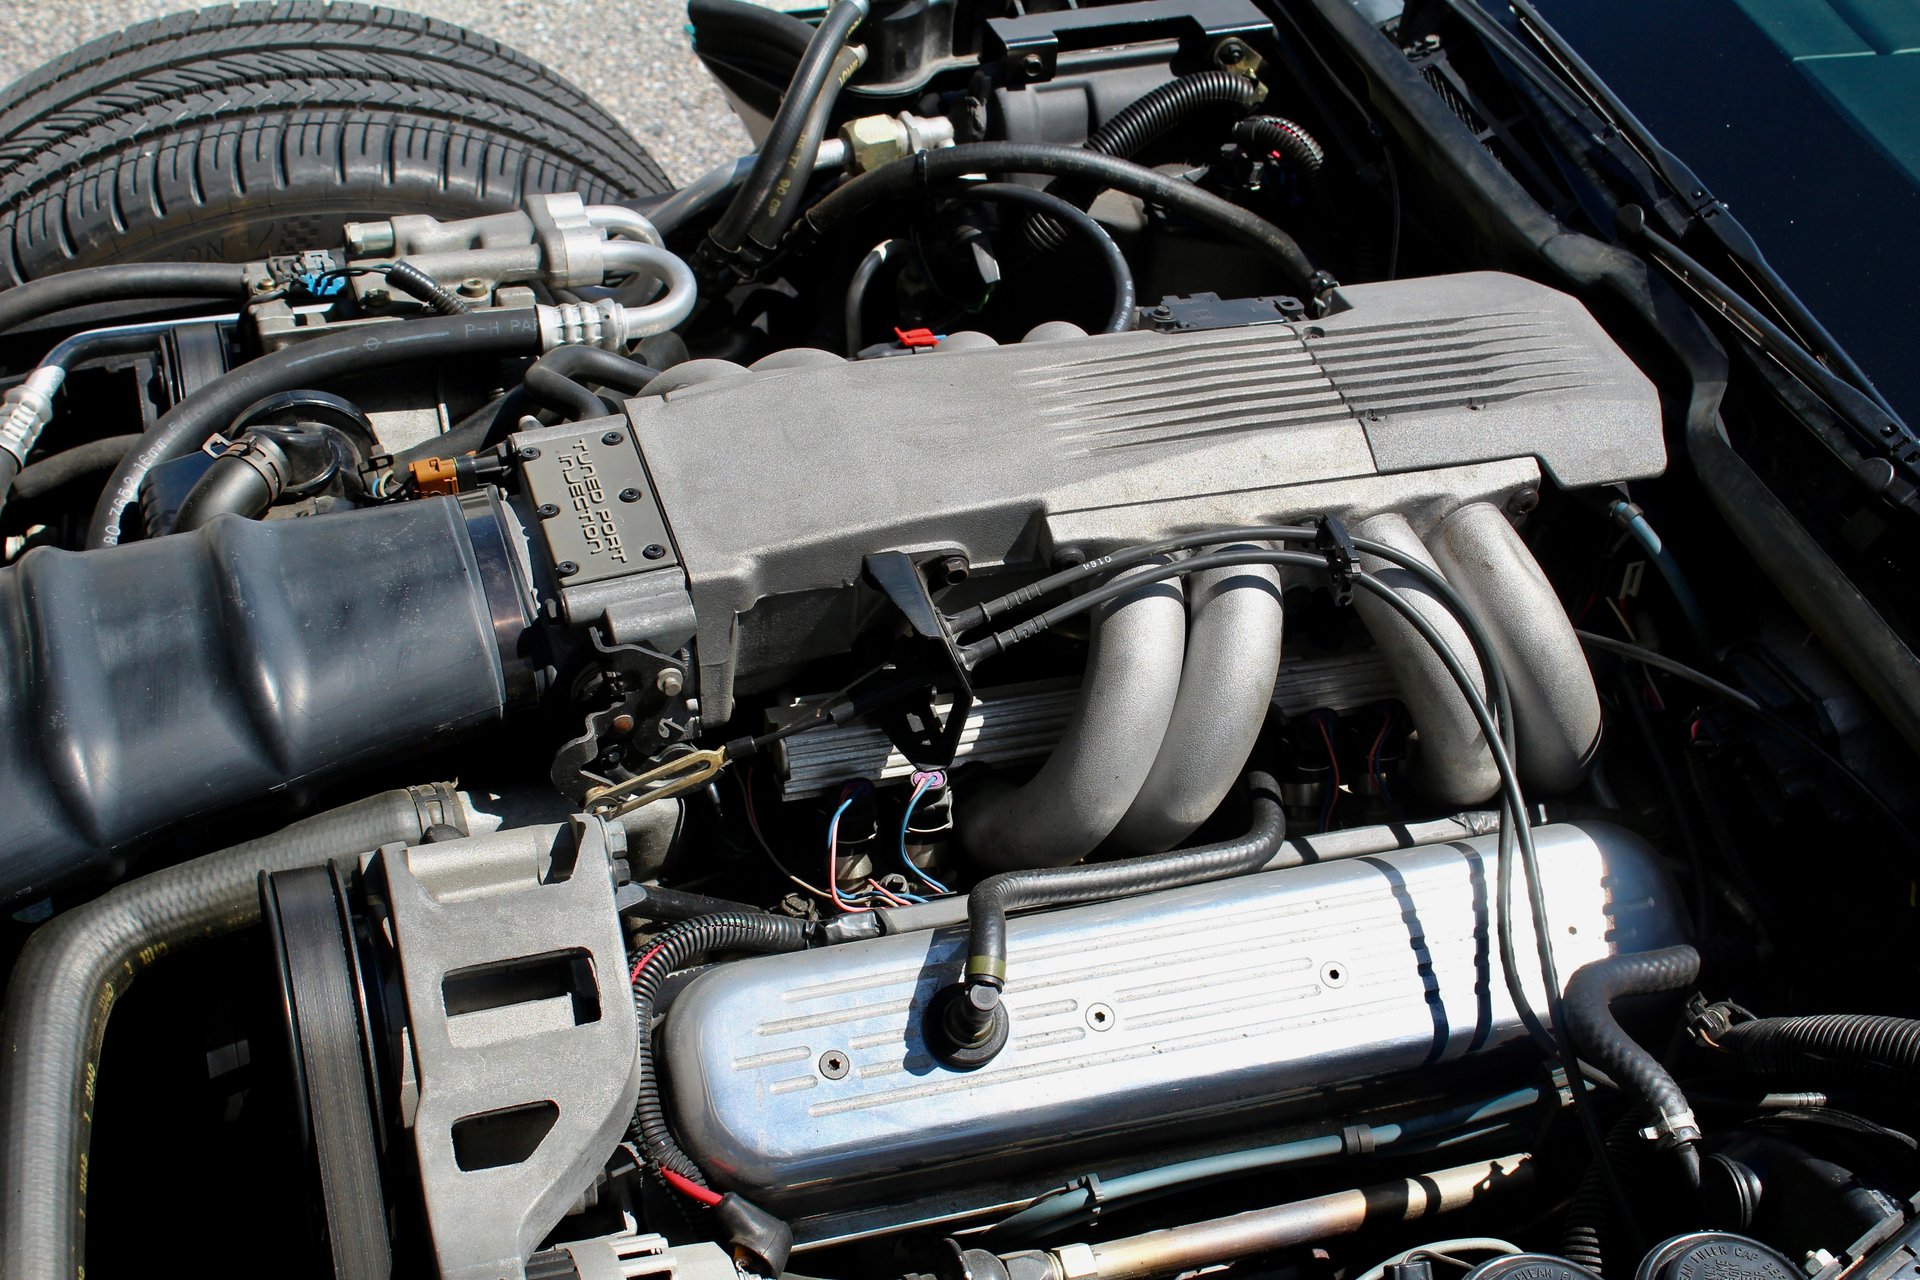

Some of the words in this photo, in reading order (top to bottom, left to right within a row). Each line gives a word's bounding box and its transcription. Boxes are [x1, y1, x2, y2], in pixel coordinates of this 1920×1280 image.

[108, 476, 138, 517] 7652
[558, 454, 604, 555] INJECTION
[573, 438, 606, 505] TUNED
[596, 508, 628, 564] PORT
[103, 524, 121, 546] 80
[1690, 1245, 1728, 1264] FILLER
[1734, 1247, 1759, 1262] CAP
